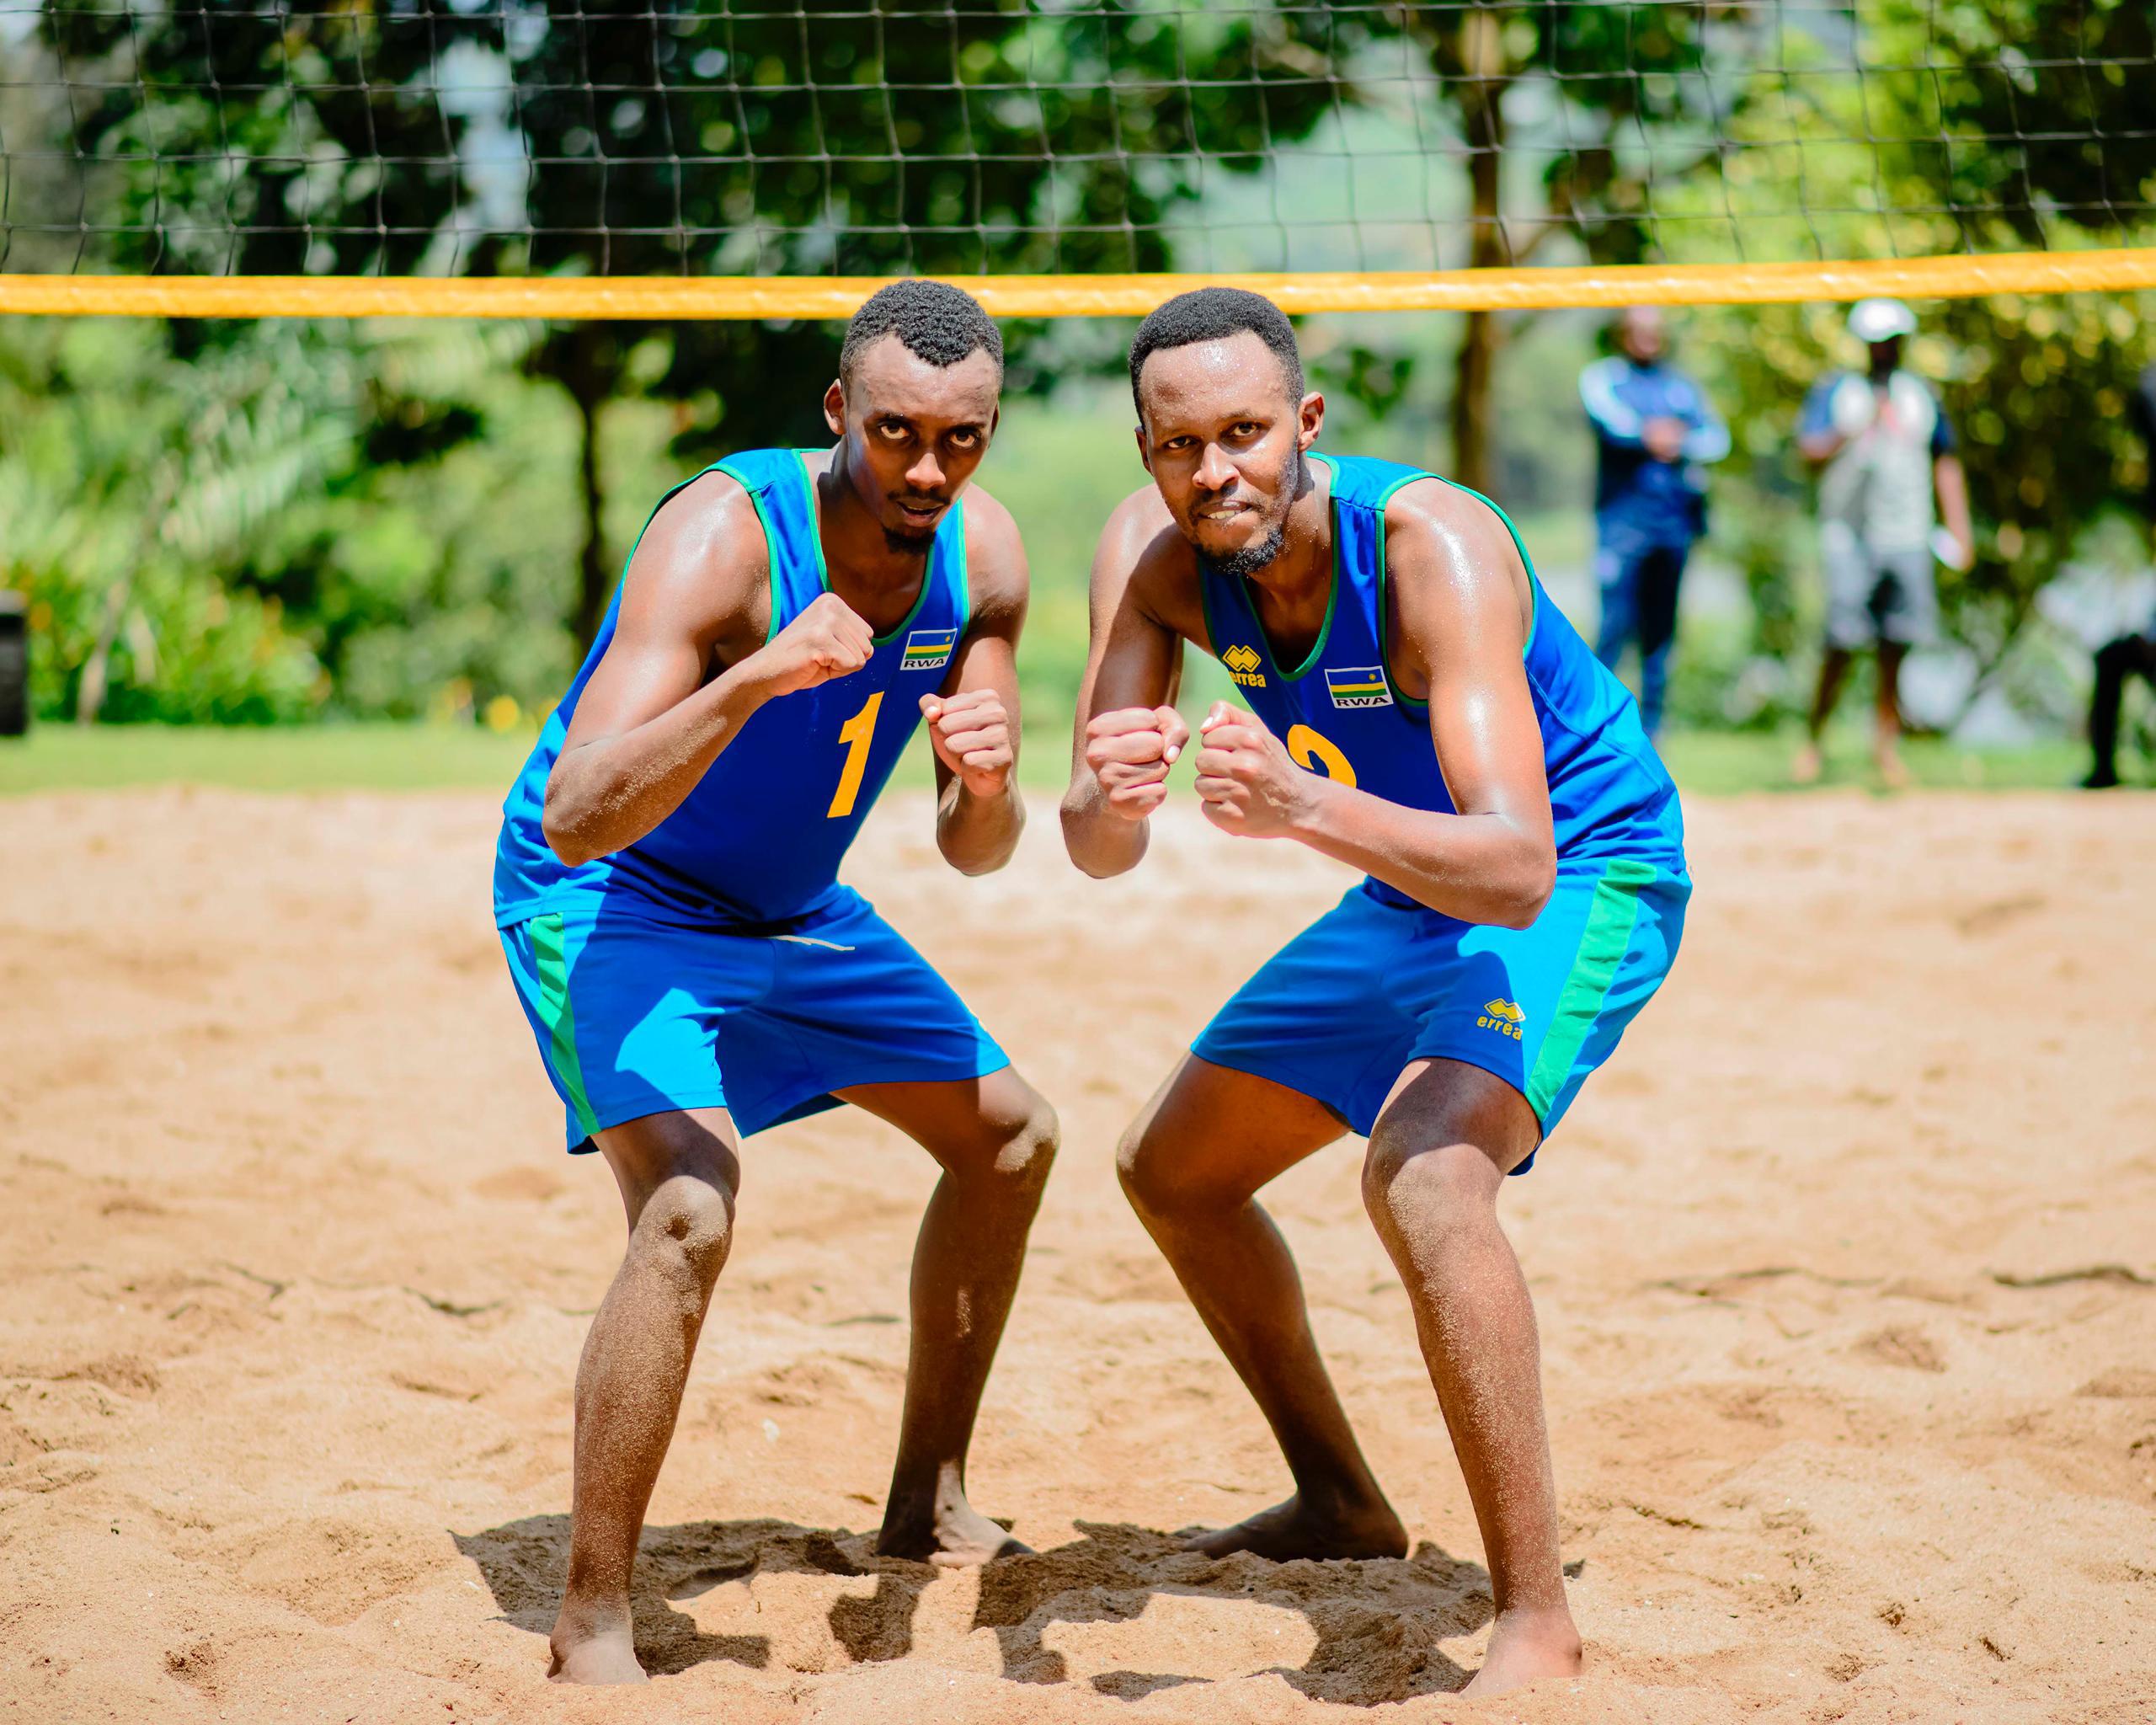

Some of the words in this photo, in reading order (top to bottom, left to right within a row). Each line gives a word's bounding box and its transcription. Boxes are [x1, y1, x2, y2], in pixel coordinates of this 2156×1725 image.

[904, 658, 945, 668] RWA
[1336, 697, 1390, 707] RWA
[827, 691, 884, 818] 1
